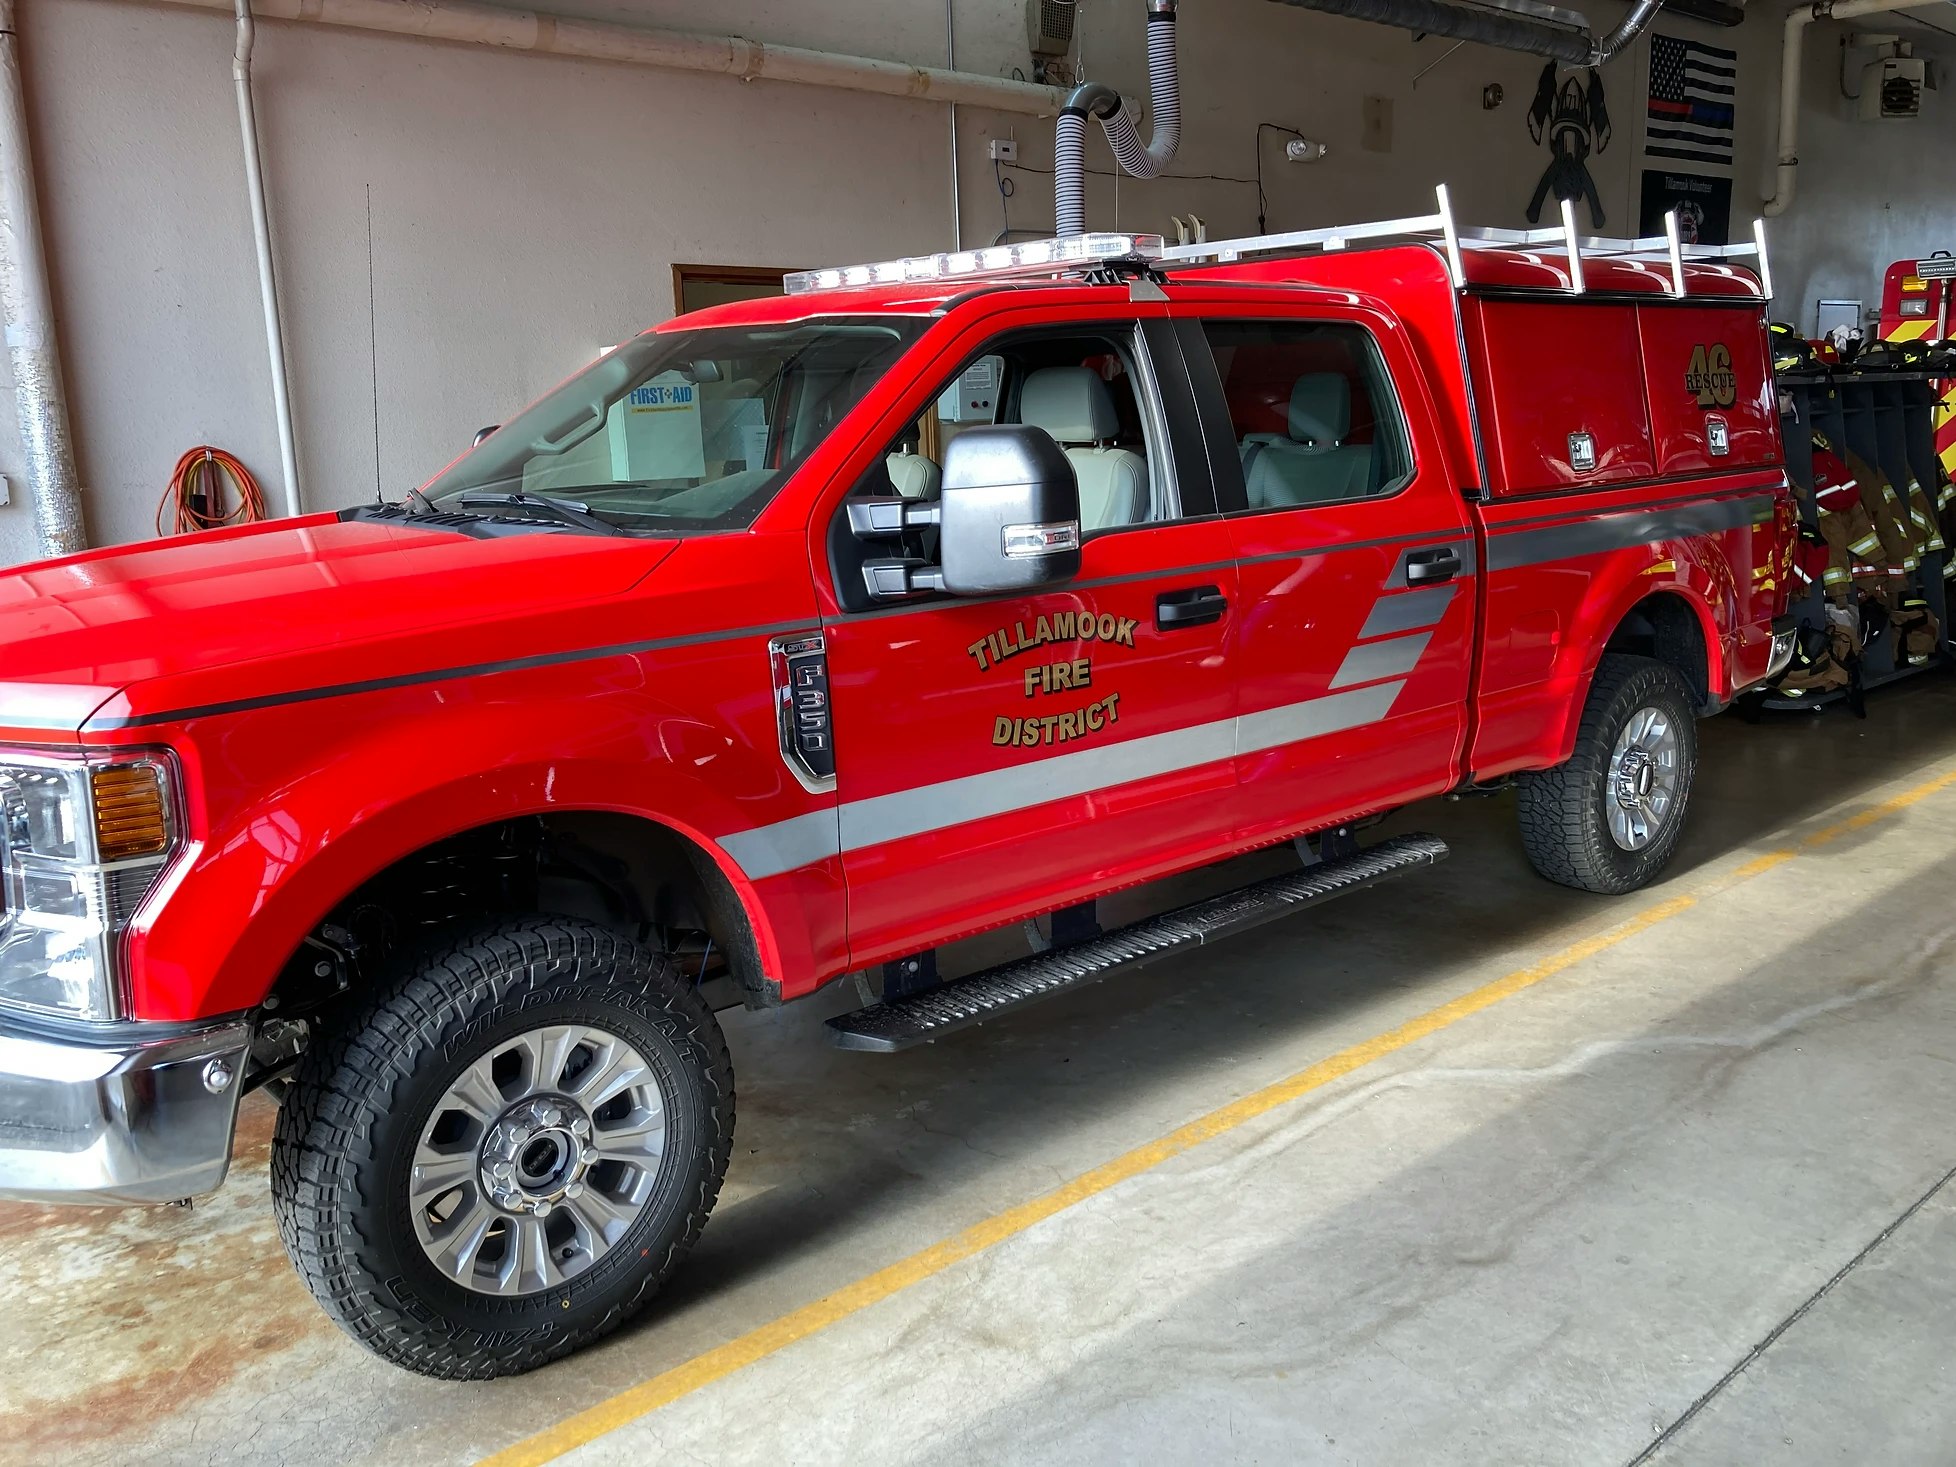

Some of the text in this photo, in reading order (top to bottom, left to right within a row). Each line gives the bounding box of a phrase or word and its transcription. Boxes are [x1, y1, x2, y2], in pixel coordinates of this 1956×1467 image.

[630, 386, 693, 405] FIRST AID
[1685, 344, 1735, 406] 46
[1685, 373, 1737, 390] RESCUE
[967, 610, 1139, 671] TILLAMOOK
[1023, 657, 1092, 697] FIRE
[992, 692, 1120, 747] DISTRICT
